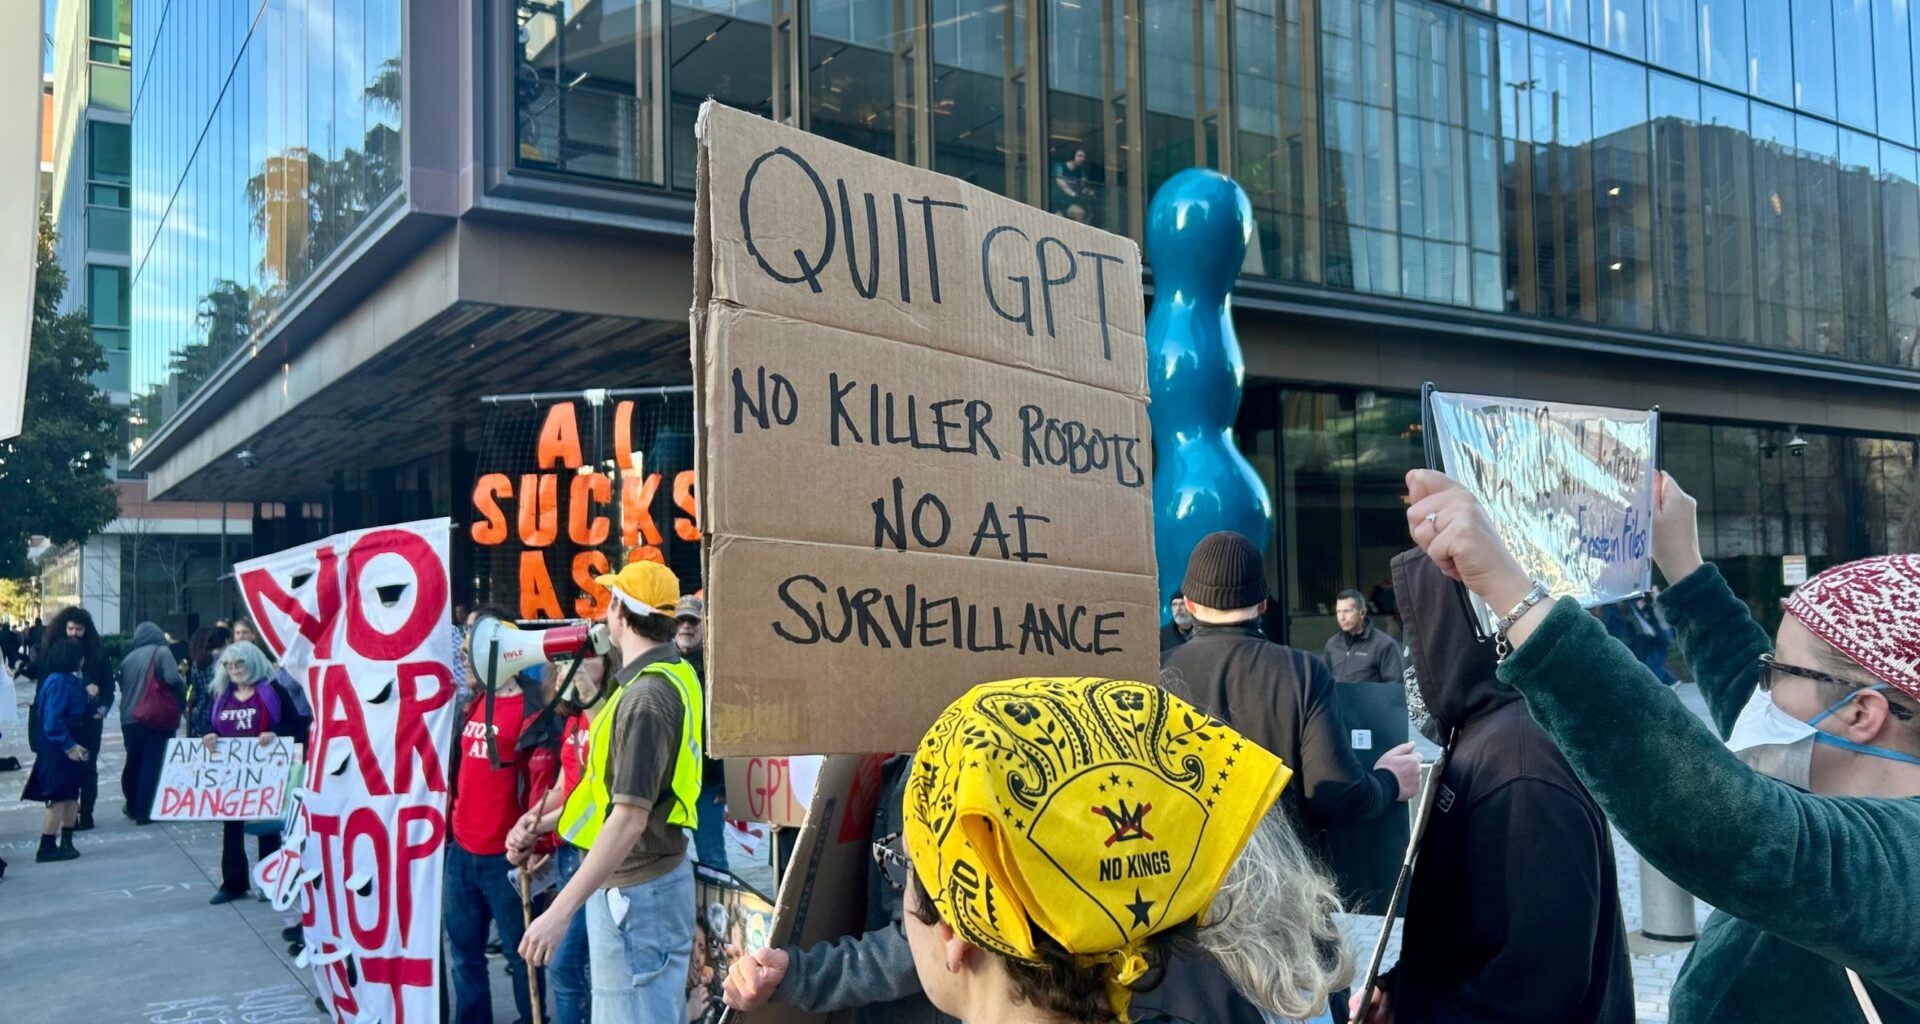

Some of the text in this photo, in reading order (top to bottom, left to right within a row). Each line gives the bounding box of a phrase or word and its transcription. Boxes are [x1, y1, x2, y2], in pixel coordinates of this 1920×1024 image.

[739, 146, 1124, 361] QUIT GPT
[537, 400, 634, 470] AI
[732, 365, 1144, 488] NO KILLER ROBOTS
[471, 470, 703, 547] SUCKS
[872, 477, 1051, 562] NO AI
[1622, 506, 1647, 563] Files
[239, 528, 448, 661] NO
[519, 545, 664, 621] AS
[771, 575, 1124, 656] SURVEILLANCE
[220, 708, 257, 721] STOP
[236, 720, 253, 731] AI
[169, 739, 289, 765] AMERICA
[195, 769, 263, 789] IS IN
[468, 740, 488, 759] AI
[160, 778, 284, 817] DANGER!
[1099, 850, 1171, 882] NO KINGS
